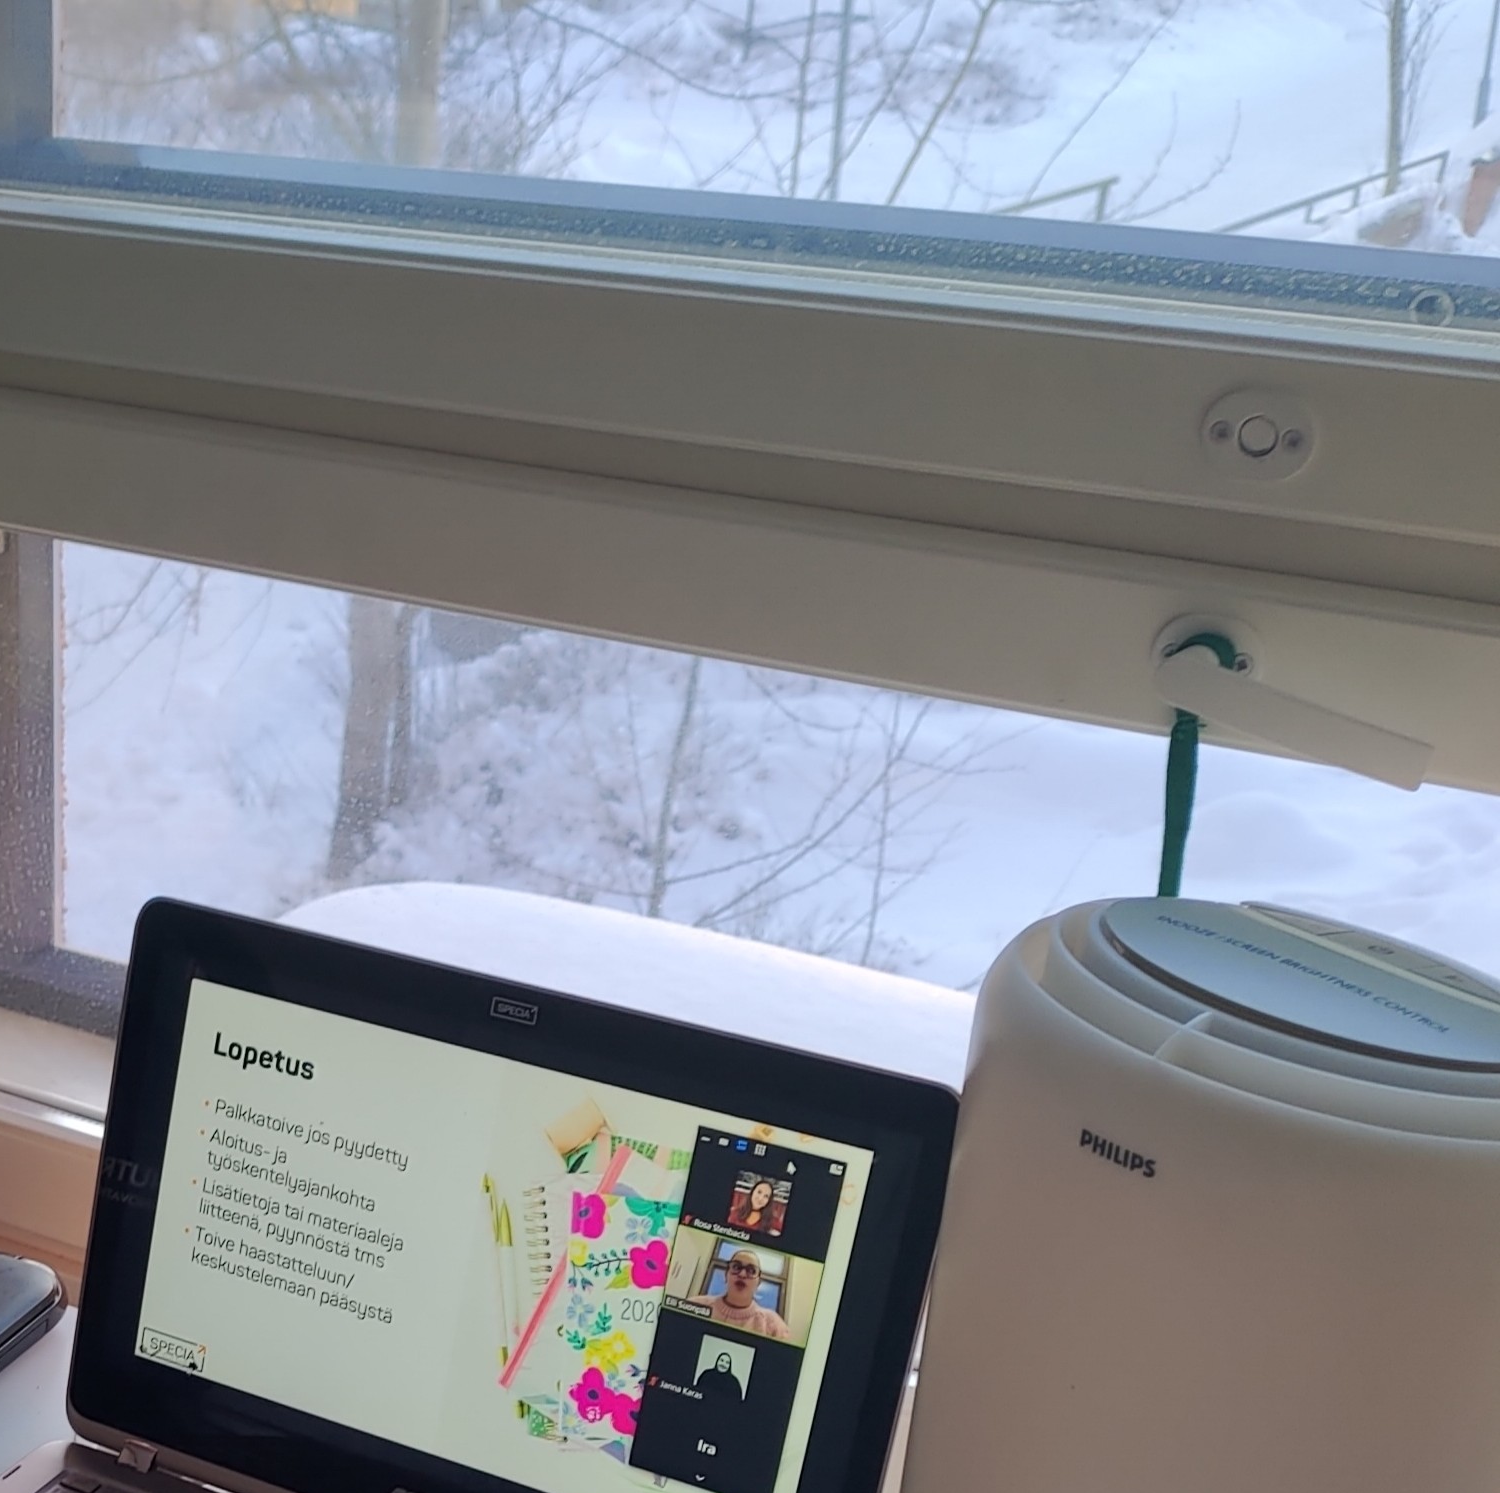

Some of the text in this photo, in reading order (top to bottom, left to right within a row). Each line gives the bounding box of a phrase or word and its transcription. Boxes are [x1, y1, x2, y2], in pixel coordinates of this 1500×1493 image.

[1224, 937, 1279, 960] SCREEN
[1280, 957, 1372, 998] BRIGHTNESS
[1372, 995, 1449, 1033] CONTROL
[213, 1032, 314, 1080] Lopetus
[210, 1129, 287, 1165] Aloitus- ja
[215, 1099, 408, 1171] Palkkatoive jos pyydetty
[1080, 1128, 1156, 1178] PHILIPS
[207, 1151, 376, 1212] työskentelyajankohta
[199, 1198, 385, 1268] liitteenä, pyynnöstä tms
[202, 1177, 403, 1252] Lisätietoja tai materiaaleja
[191, 1247, 393, 1324] keskustelemaan pääsystä
[195, 1225, 355, 1288] Toive haastatteluun/
[149, 1337, 195, 1361] SPECIA
